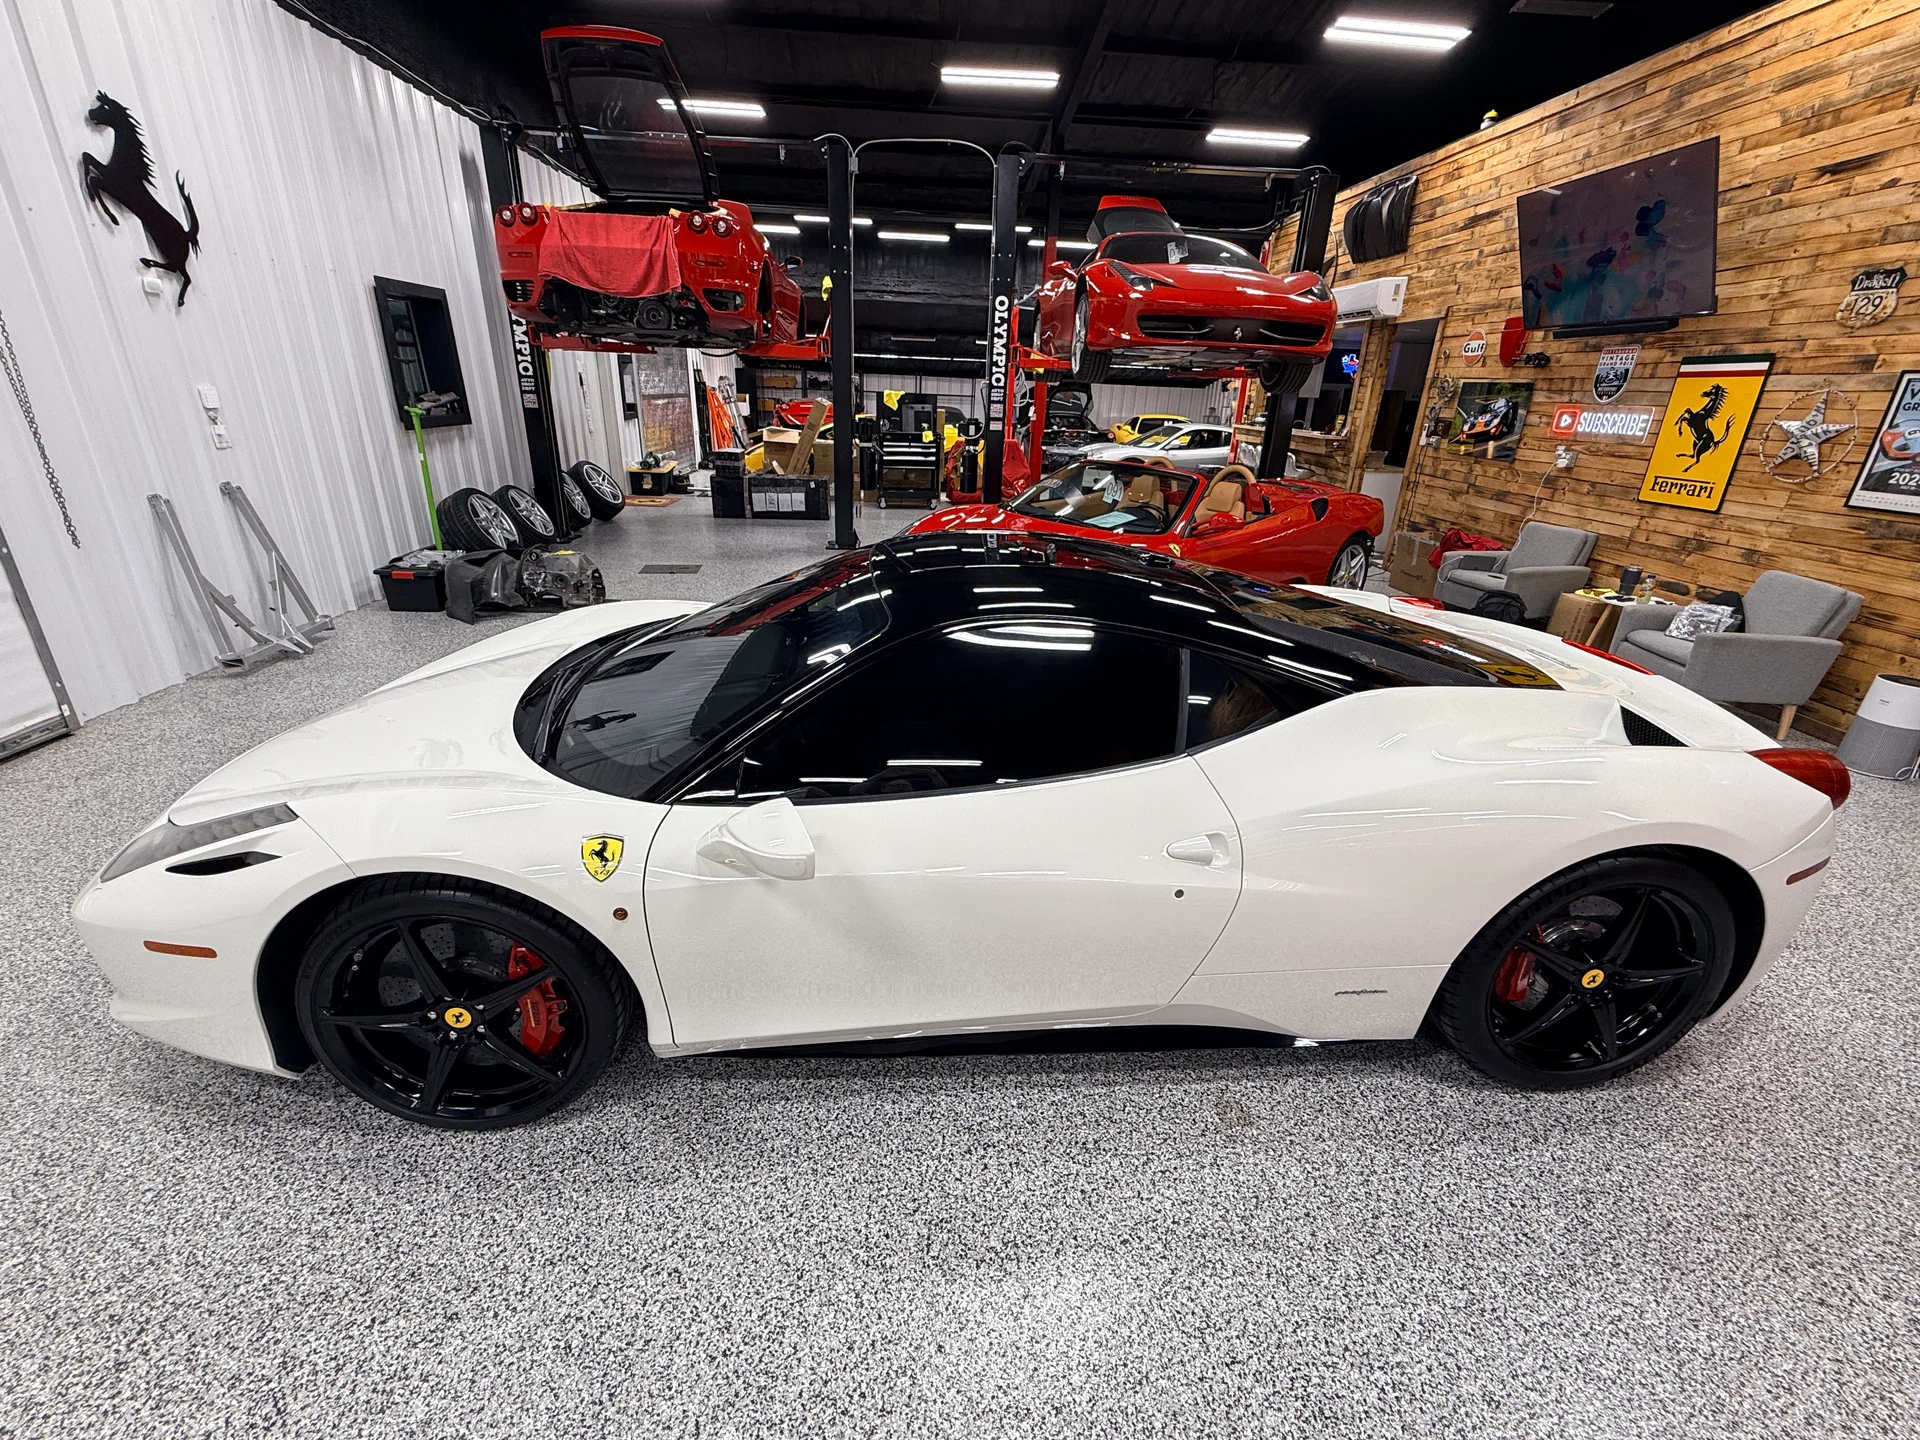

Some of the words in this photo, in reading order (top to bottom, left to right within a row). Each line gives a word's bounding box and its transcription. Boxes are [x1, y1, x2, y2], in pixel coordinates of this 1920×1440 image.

[1854, 272, 1900, 290] Dragon
[1849, 295, 1884, 316] 129
[511, 313, 534, 376] YMPIC
[991, 295, 1010, 387] OLYMPIC
[1463, 343, 1486, 354] Gulf
[1601, 354, 1636, 362] VINTAGE
[1577, 411, 1650, 436] SUBSCRIBE
[1649, 475, 1716, 499] Ferrari
[1888, 471, 1920, 486] 202
